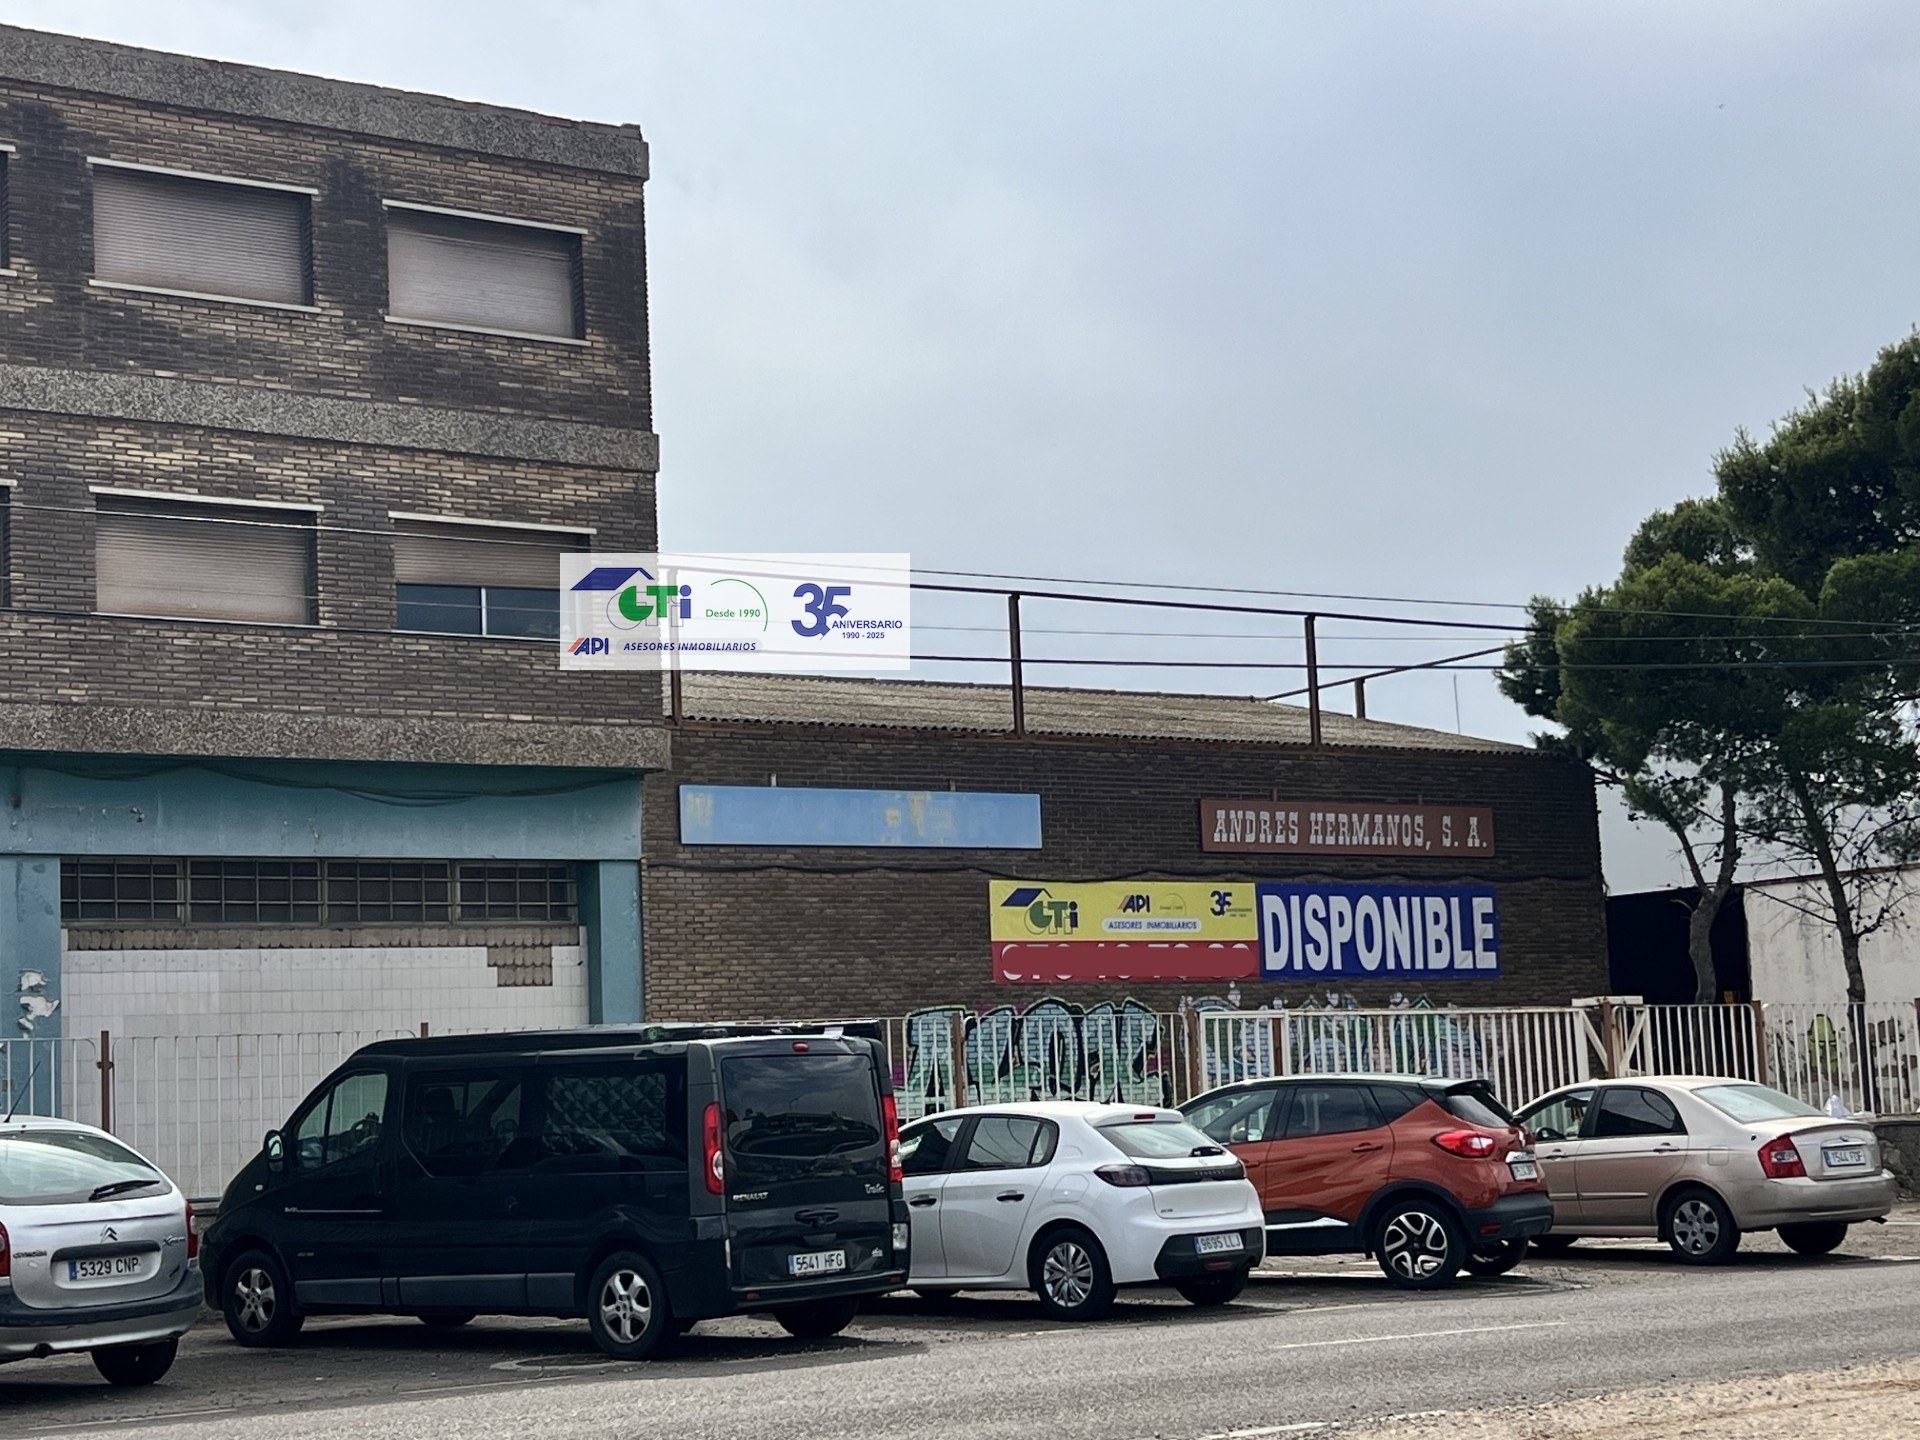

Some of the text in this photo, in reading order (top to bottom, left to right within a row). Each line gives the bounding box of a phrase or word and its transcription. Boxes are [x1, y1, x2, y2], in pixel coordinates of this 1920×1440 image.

[1213, 810, 1488, 851] ANDRES HERMANOS, S. A.
[1118, 895, 1150, 913] API
[1108, 921, 1197, 930] ASESORES INMOBILIARIOS
[1262, 894, 1497, 971] DISPONIBLE
[80, 1257, 139, 1277] 5329 CNP
[796, 1253, 843, 1270] 5541 HFG
